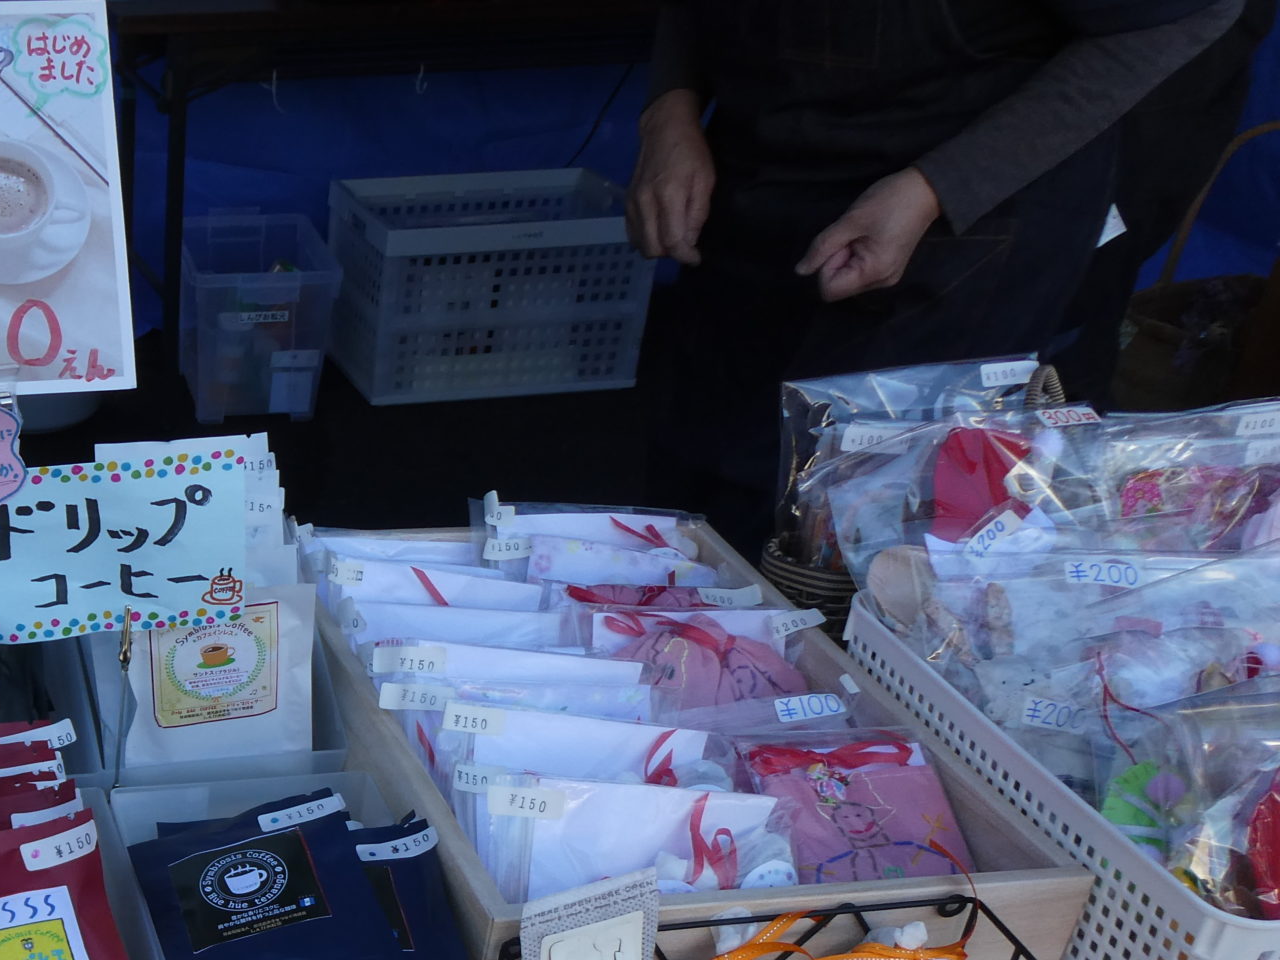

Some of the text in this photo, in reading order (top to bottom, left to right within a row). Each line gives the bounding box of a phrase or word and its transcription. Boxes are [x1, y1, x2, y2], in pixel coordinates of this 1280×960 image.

[27, 32, 92, 57] はじめ
[37, 58, 95, 85] ました
[31, 563, 208, 608] コーヒー
[1069, 562, 1139, 587] ¥200
[400, 657, 434, 672] ¥150
[779, 694, 841, 719] ¥100
[453, 714, 489, 730] ¥150
[286, 802, 325, 820] ¥150
[508, 793, 548, 814] ¥150
[54, 832, 92, 858] ¥150
[391, 832, 430, 855] ¥150
[203, 851, 278, 885] Symbiosis Coffee
